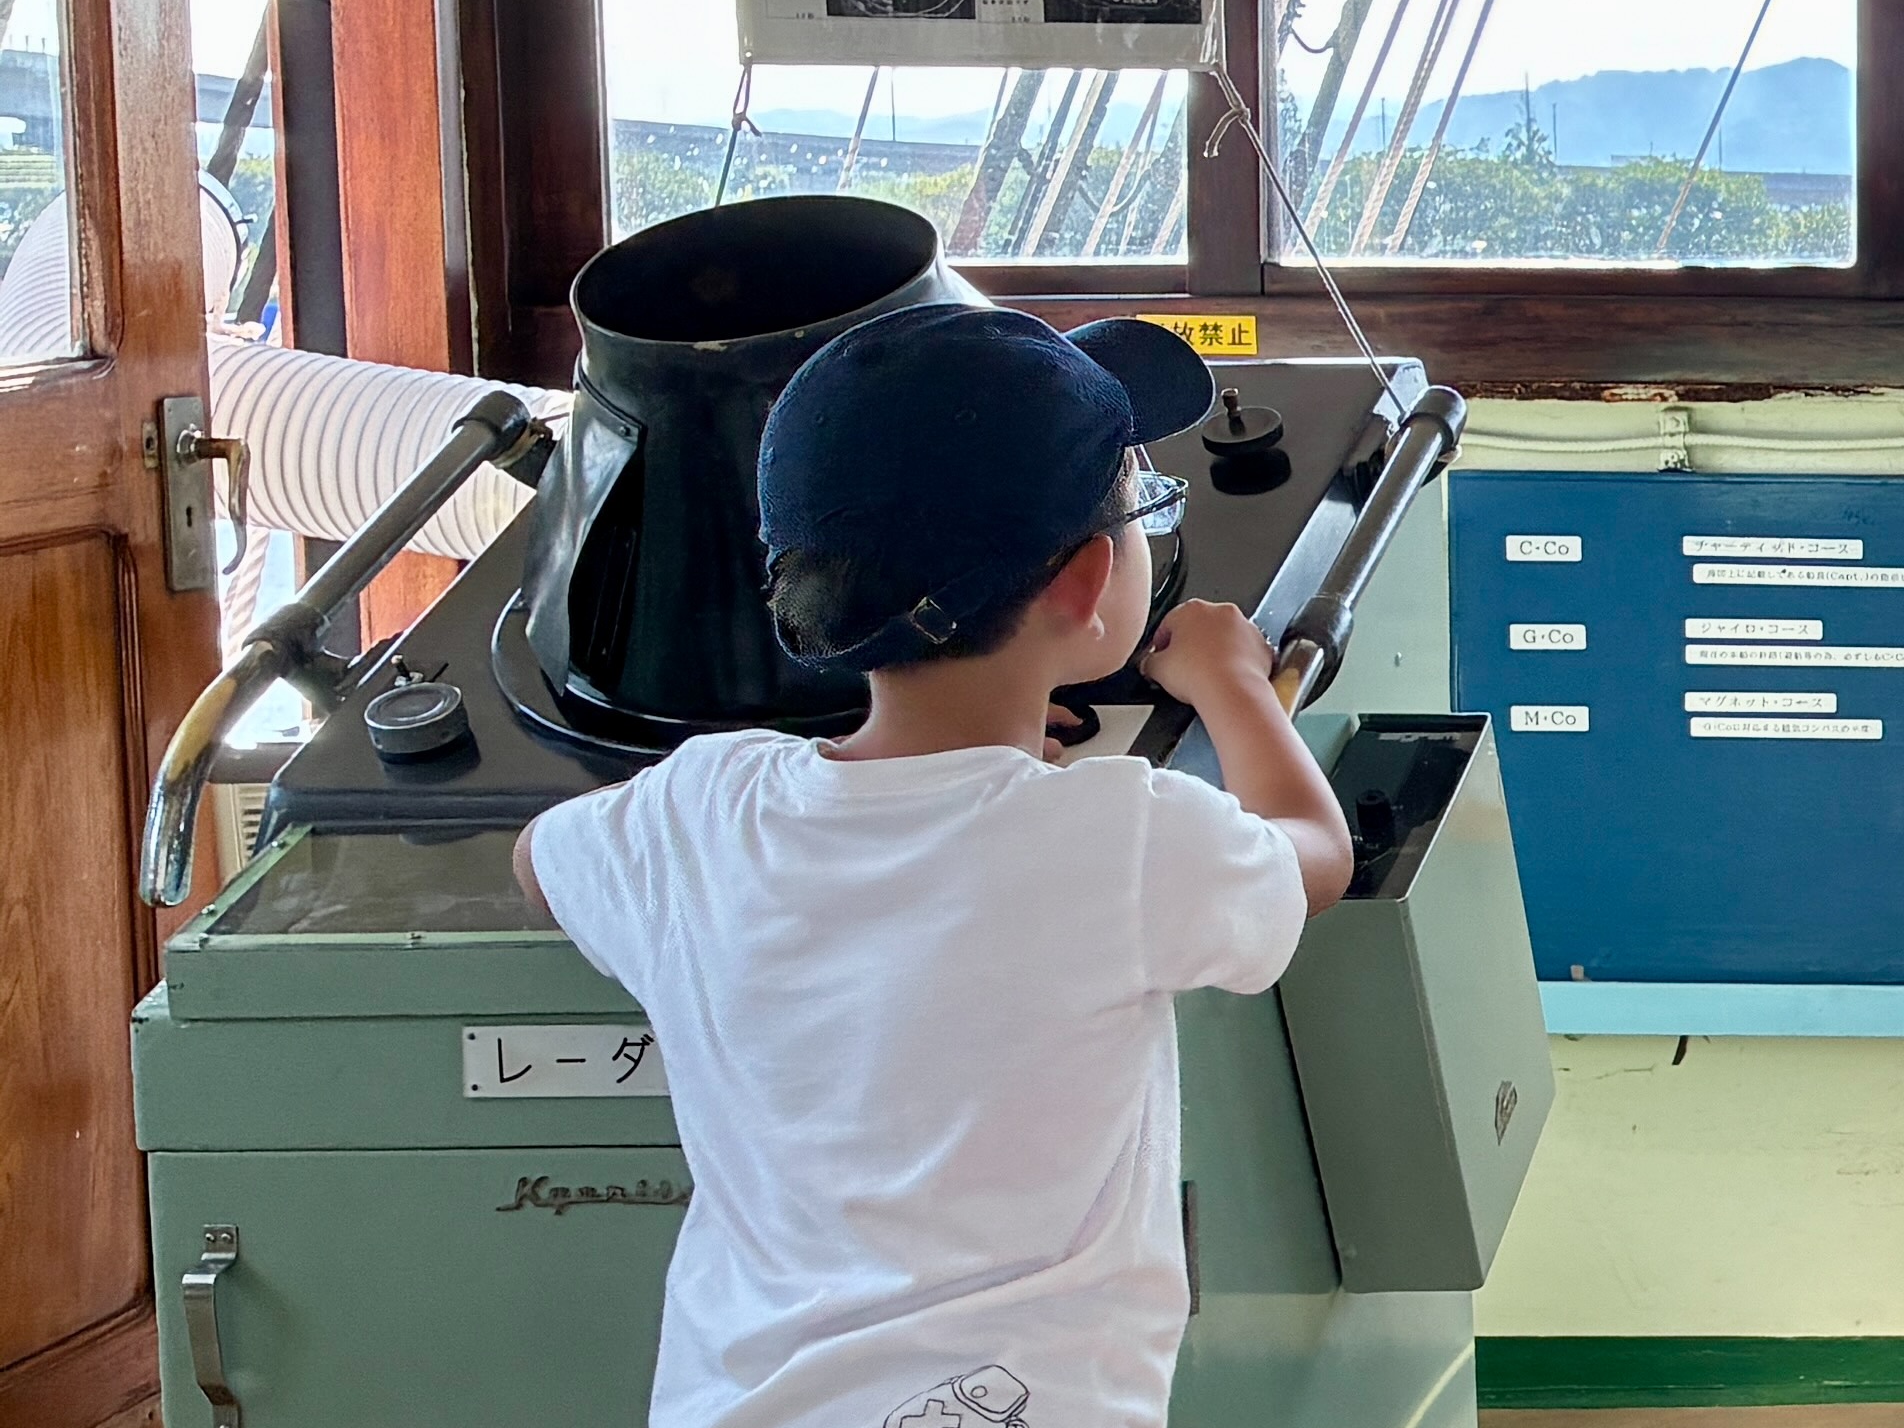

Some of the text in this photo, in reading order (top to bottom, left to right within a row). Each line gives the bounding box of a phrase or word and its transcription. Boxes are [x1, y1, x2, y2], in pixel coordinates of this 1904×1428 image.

[1172, 322, 1252, 346] 放禁止
[496, 1034, 655, 1084] レーダ
